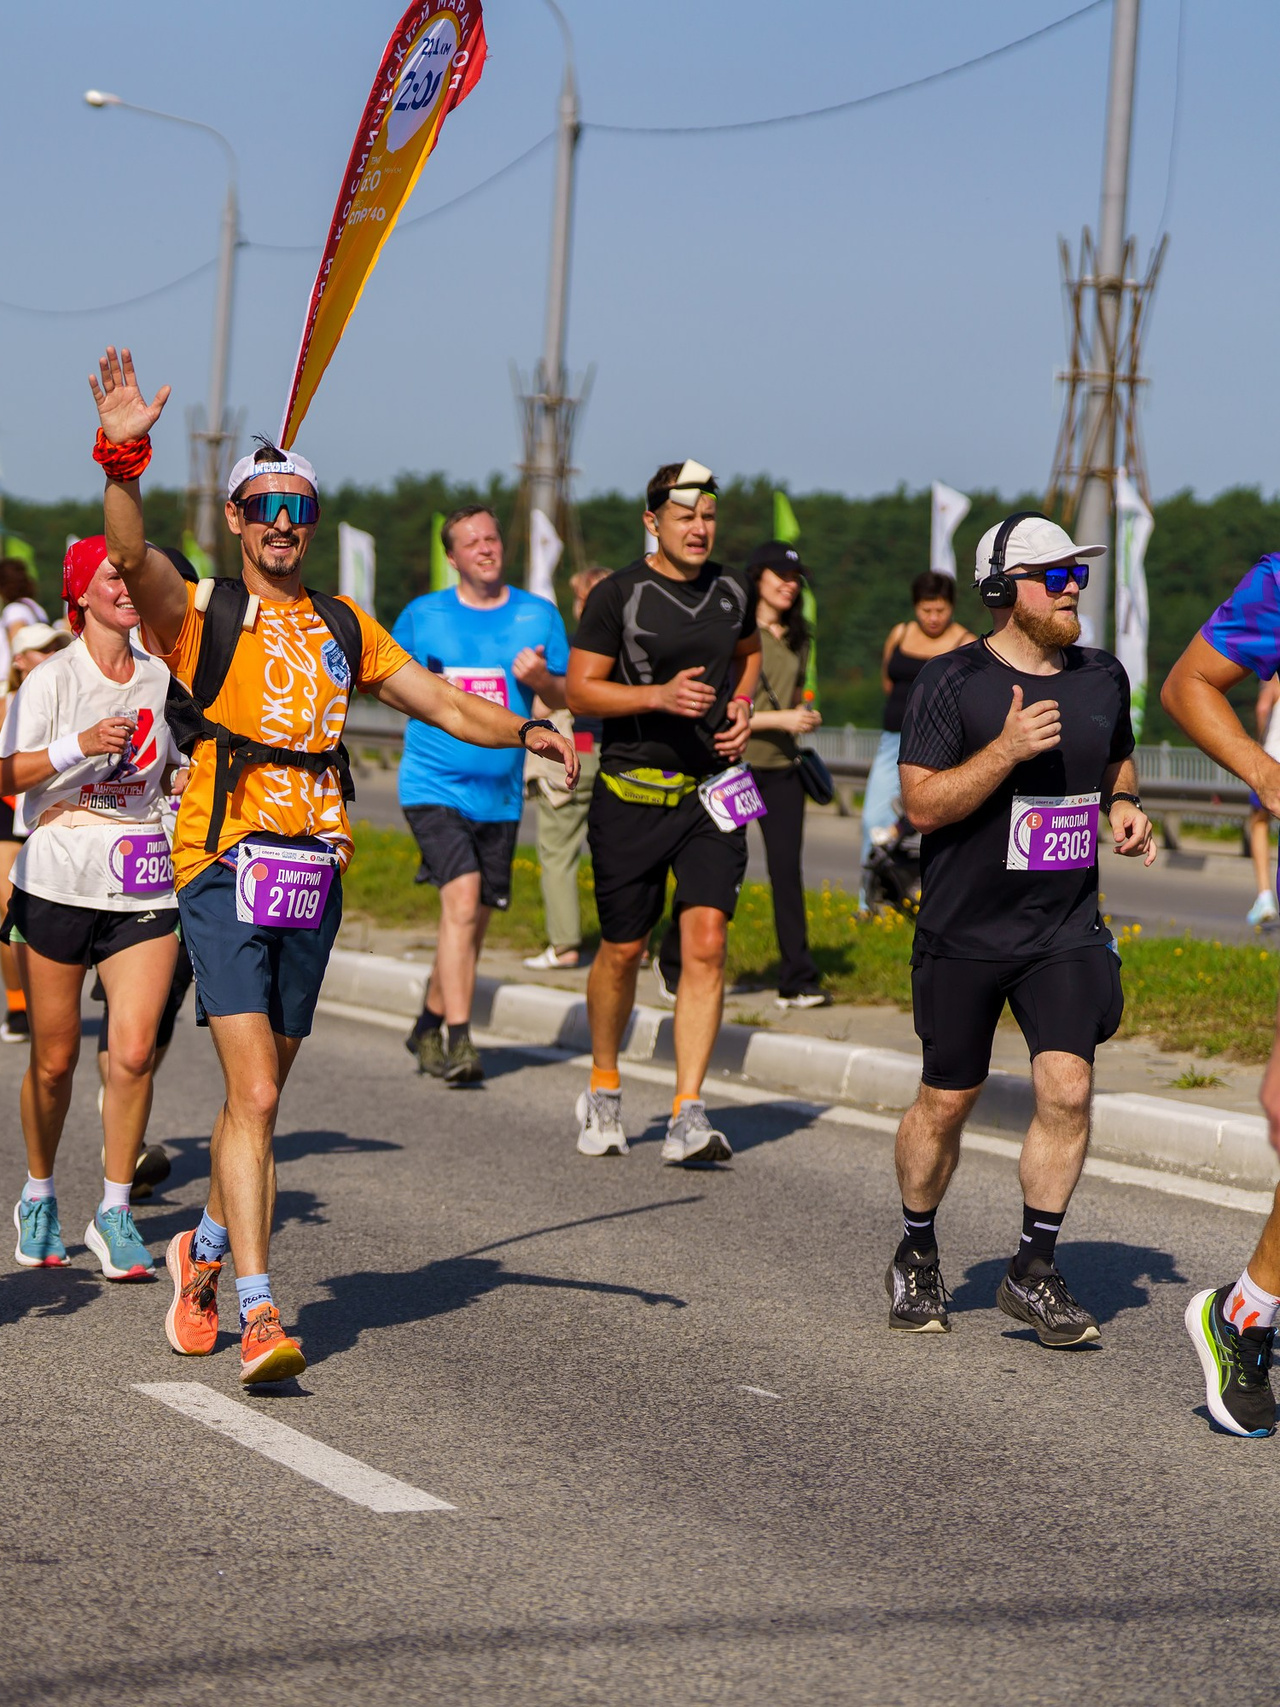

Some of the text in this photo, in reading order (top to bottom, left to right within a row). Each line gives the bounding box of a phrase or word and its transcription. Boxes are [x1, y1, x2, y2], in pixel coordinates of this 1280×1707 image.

[93, 784, 144, 795] МАНУФАКТУРЫ
[1051, 811, 1089, 829] НИКОЛАЙ
[1043, 829, 1091, 861] 2303
[135, 855, 174, 884] 2928
[276, 868, 322, 886] ДМИТРИЙ
[267, 886, 320, 919] 2109
